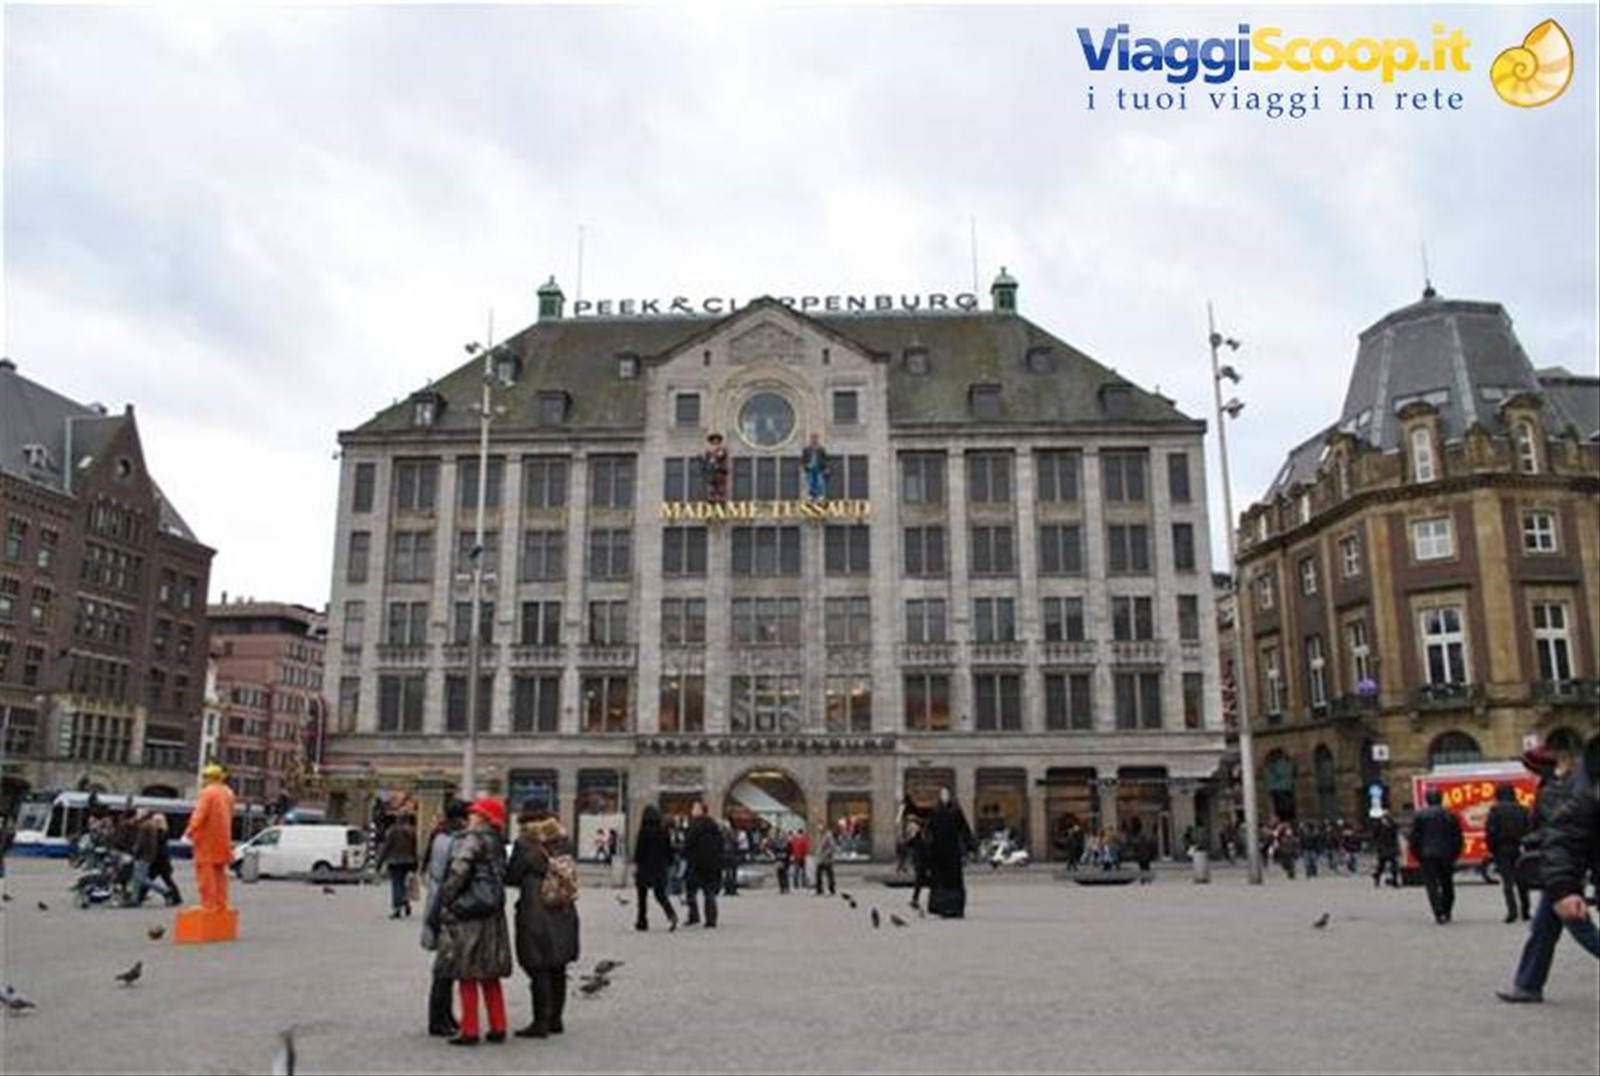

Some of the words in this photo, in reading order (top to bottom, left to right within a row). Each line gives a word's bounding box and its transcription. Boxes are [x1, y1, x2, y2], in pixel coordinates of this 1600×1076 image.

[573, 298, 661, 316] PEEK
[702, 292, 979, 314] CLPPENBURG
[658, 500, 758, 519] MADAME
[771, 498, 871, 518] TUSSAUD
